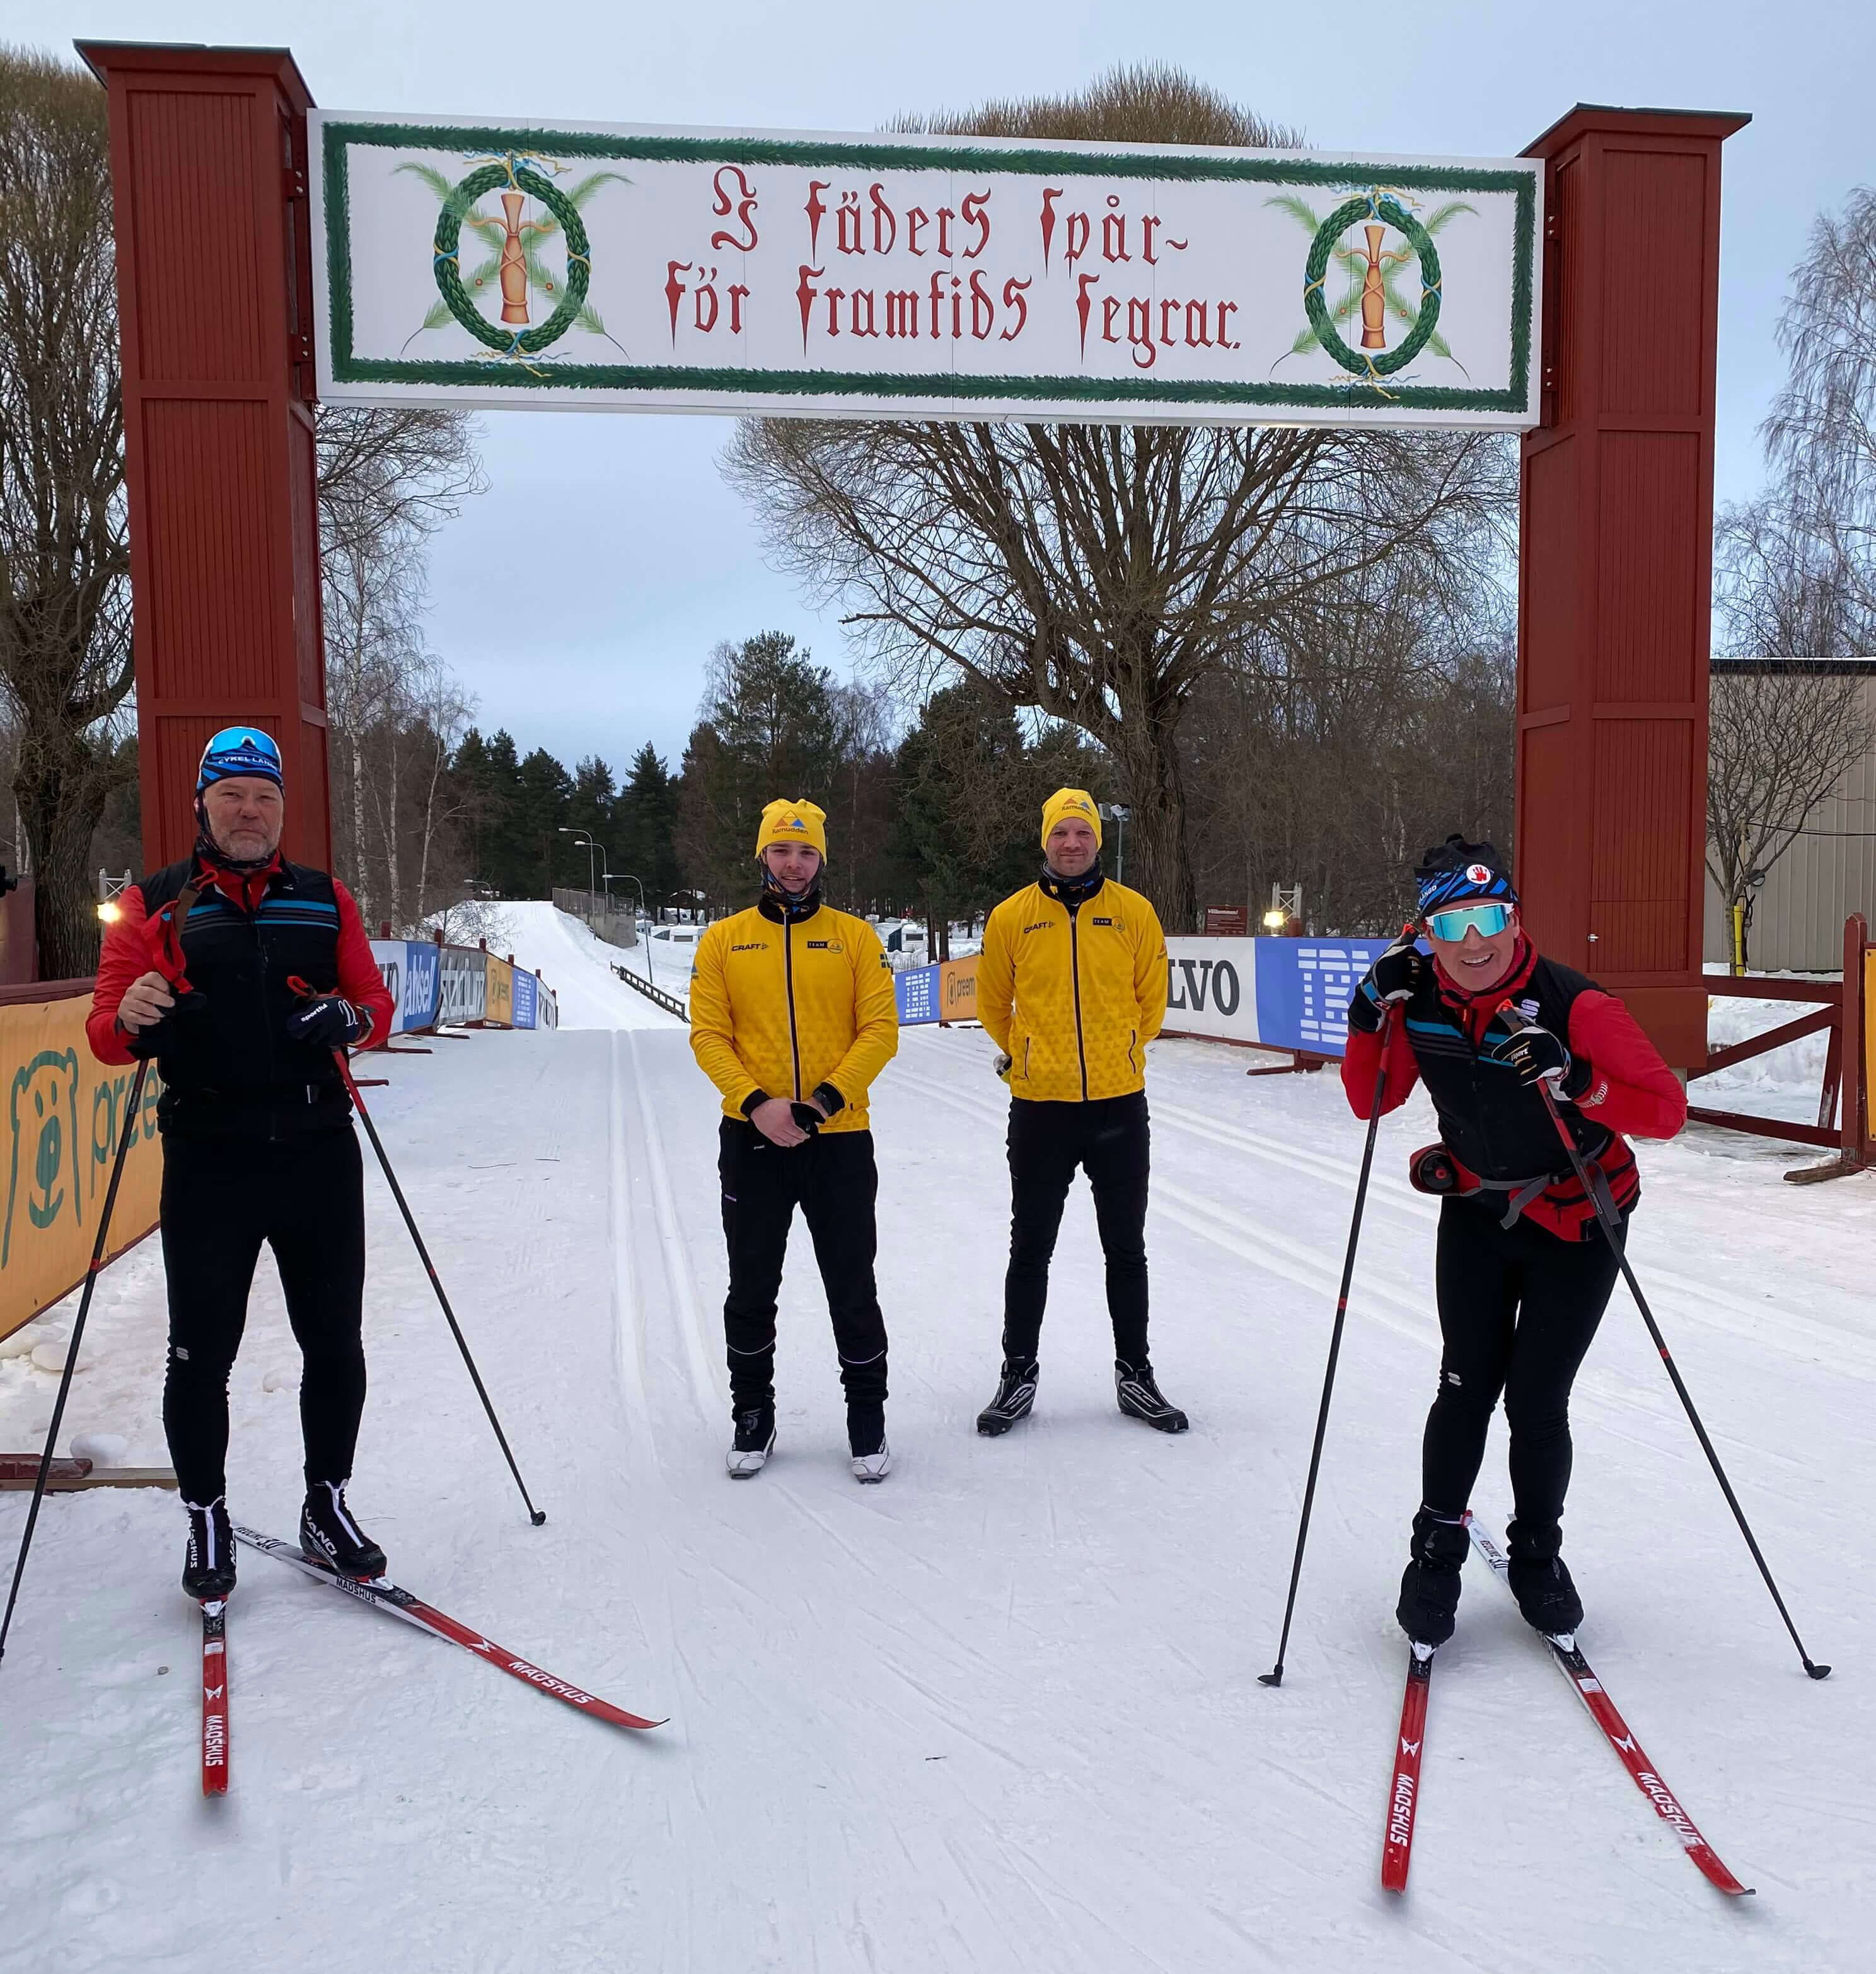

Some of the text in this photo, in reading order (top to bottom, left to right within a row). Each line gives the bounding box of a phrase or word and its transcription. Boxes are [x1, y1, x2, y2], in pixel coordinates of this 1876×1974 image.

[218, 756, 250, 765] CYKEL
[731, 944, 761, 952] CRAFT
[403, 954, 436, 1017] ahlsell
[905, 972, 930, 1019] IBM
[957, 976, 975, 1007] preem
[1167, 959, 1239, 1016] LVO
[1298, 949, 1370, 1044] IB
[335, 1577, 376, 1604] MADSHUS
[508, 1661, 594, 1705] MADSHUS
[205, 1714, 224, 1767] MADSHUS
[1389, 1772, 1414, 1847] MADSHUS
